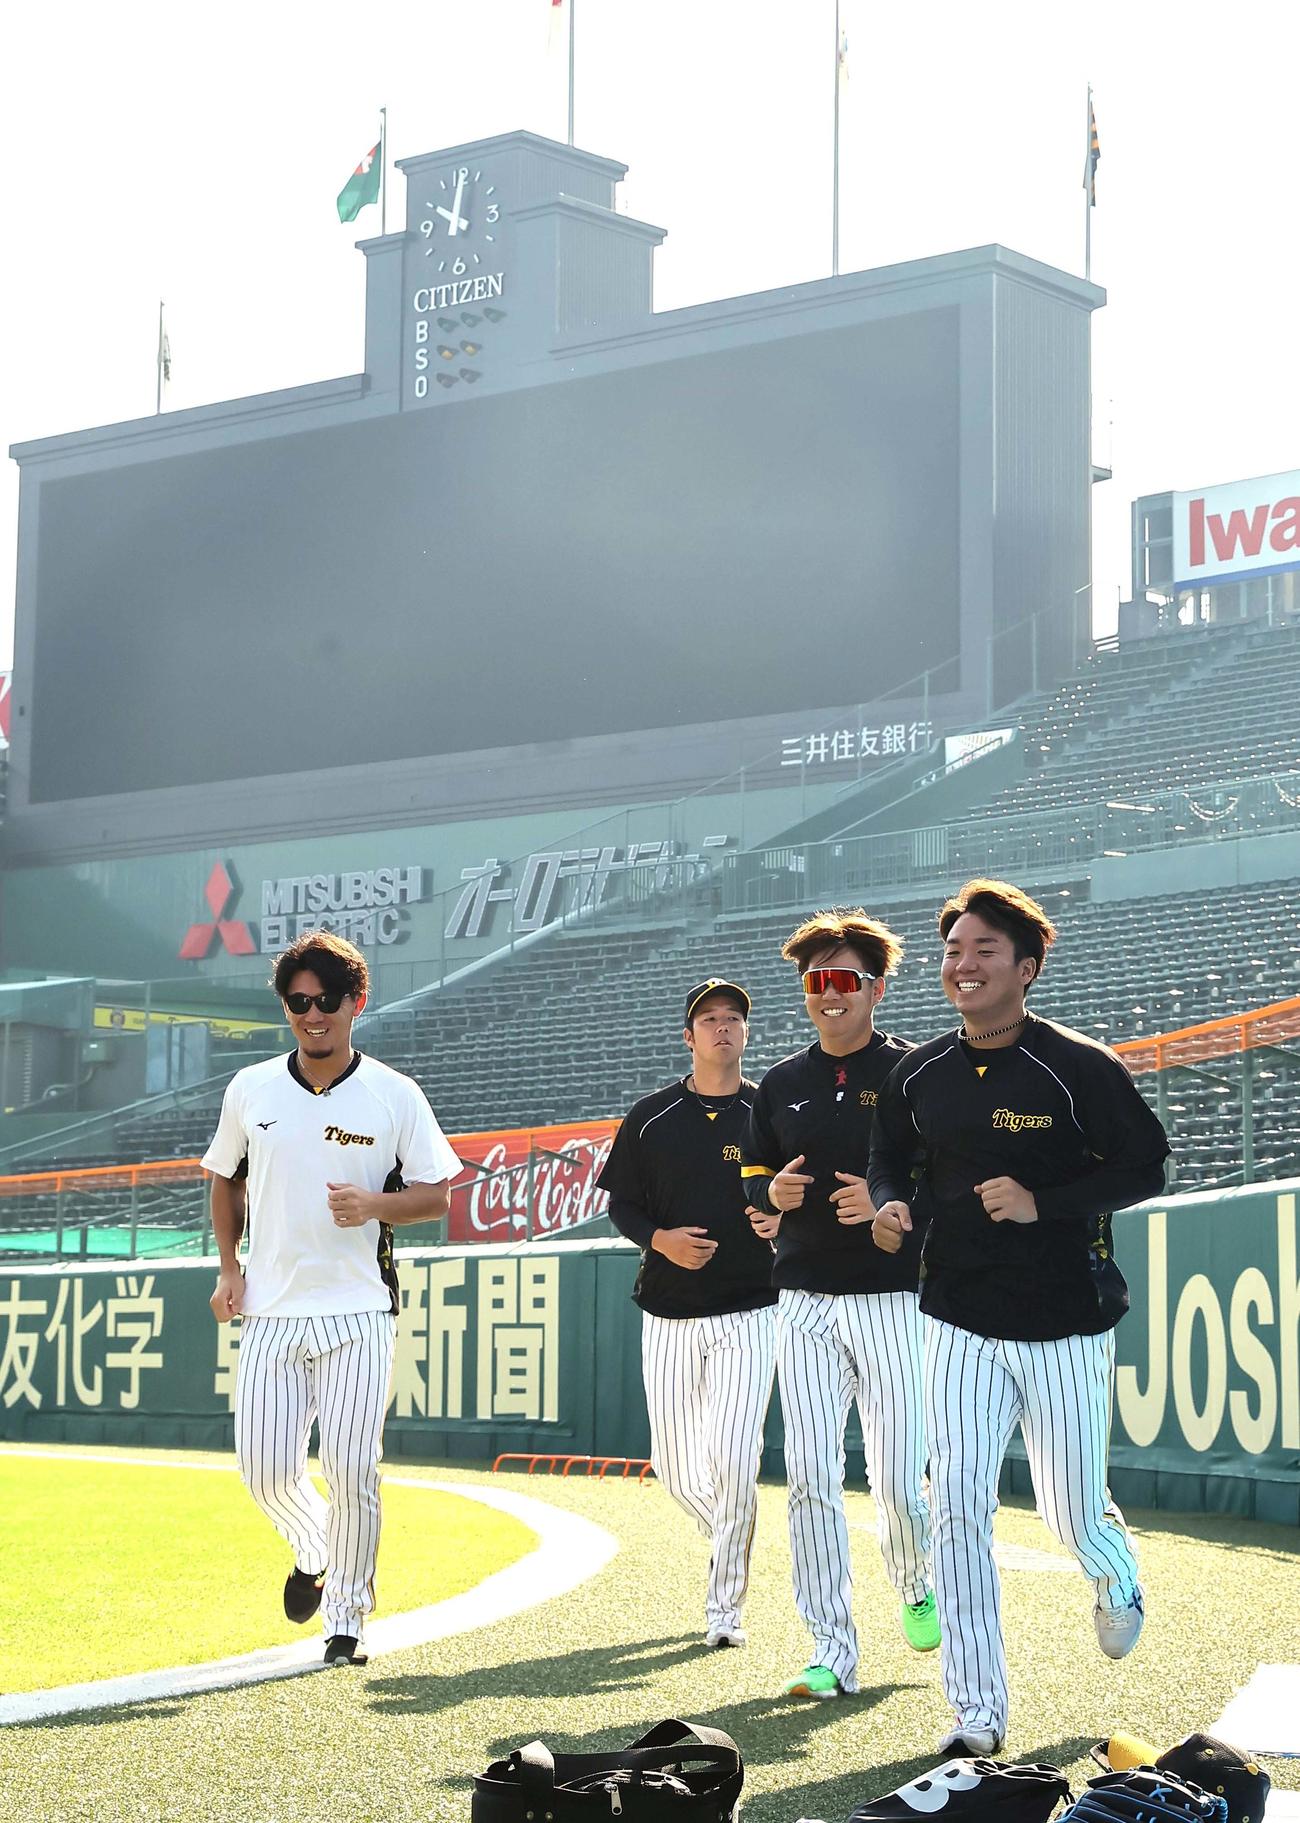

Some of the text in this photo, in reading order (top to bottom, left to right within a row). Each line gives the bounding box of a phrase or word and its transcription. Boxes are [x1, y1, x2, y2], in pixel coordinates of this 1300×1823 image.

[486, 204, 500, 223] 3
[420, 220, 434, 238] 9
[452, 257, 467, 275] 6
[413, 273, 504, 313] CITIZEN
[415, 320, 429, 343] B
[415, 348, 429, 370] S
[1189, 496, 1300, 567] Iwa
[781, 721, 933, 766] 三井住友銀行
[261, 865, 423, 916] MITSUBISHI
[992, 1108, 1053, 1132] Tigers
[324, 1125, 376, 1146] Tigers
[0, 1275, 165, 1411] 友化学
